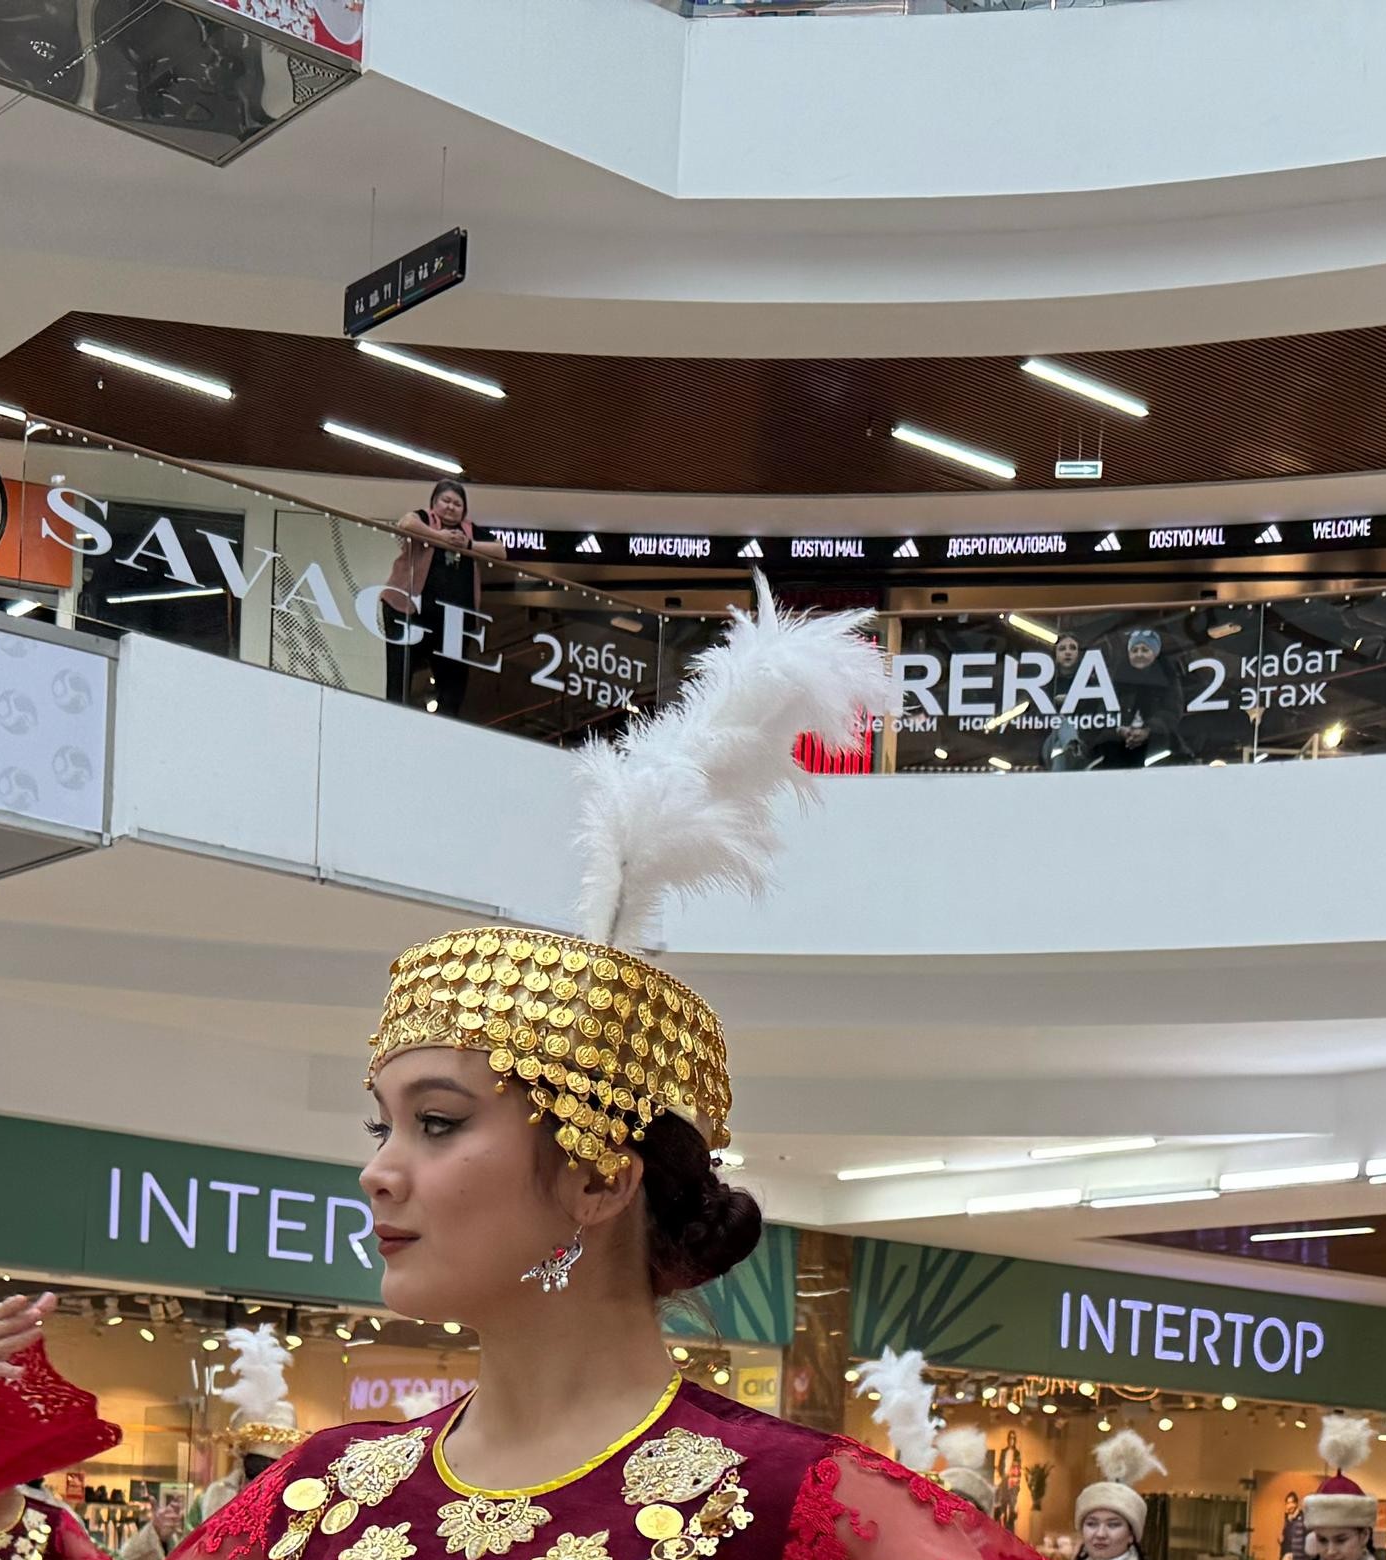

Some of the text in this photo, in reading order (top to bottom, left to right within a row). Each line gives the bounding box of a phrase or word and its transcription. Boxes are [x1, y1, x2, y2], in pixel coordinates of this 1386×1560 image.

[517, 531, 547, 550] MALL
[1194, 527, 1226, 547] MALL
[1312, 518, 1372, 541] WELCOME
[834, 539, 865, 558] MALL
[946, 535, 1067, 558] ДОБРО ПОЖАЛОВАТЬ
[41, 486, 504, 674] SAVAGE
[530, 633, 565, 693] 2
[566, 670, 634, 709] этаж
[1186, 658, 1230, 712] 2
[1239, 681, 1327, 710] этаж
[891, 715, 938, 734] очки
[1066, 712, 1121, 731] часы
[1061, 1292, 1325, 1375] INTERTOP
